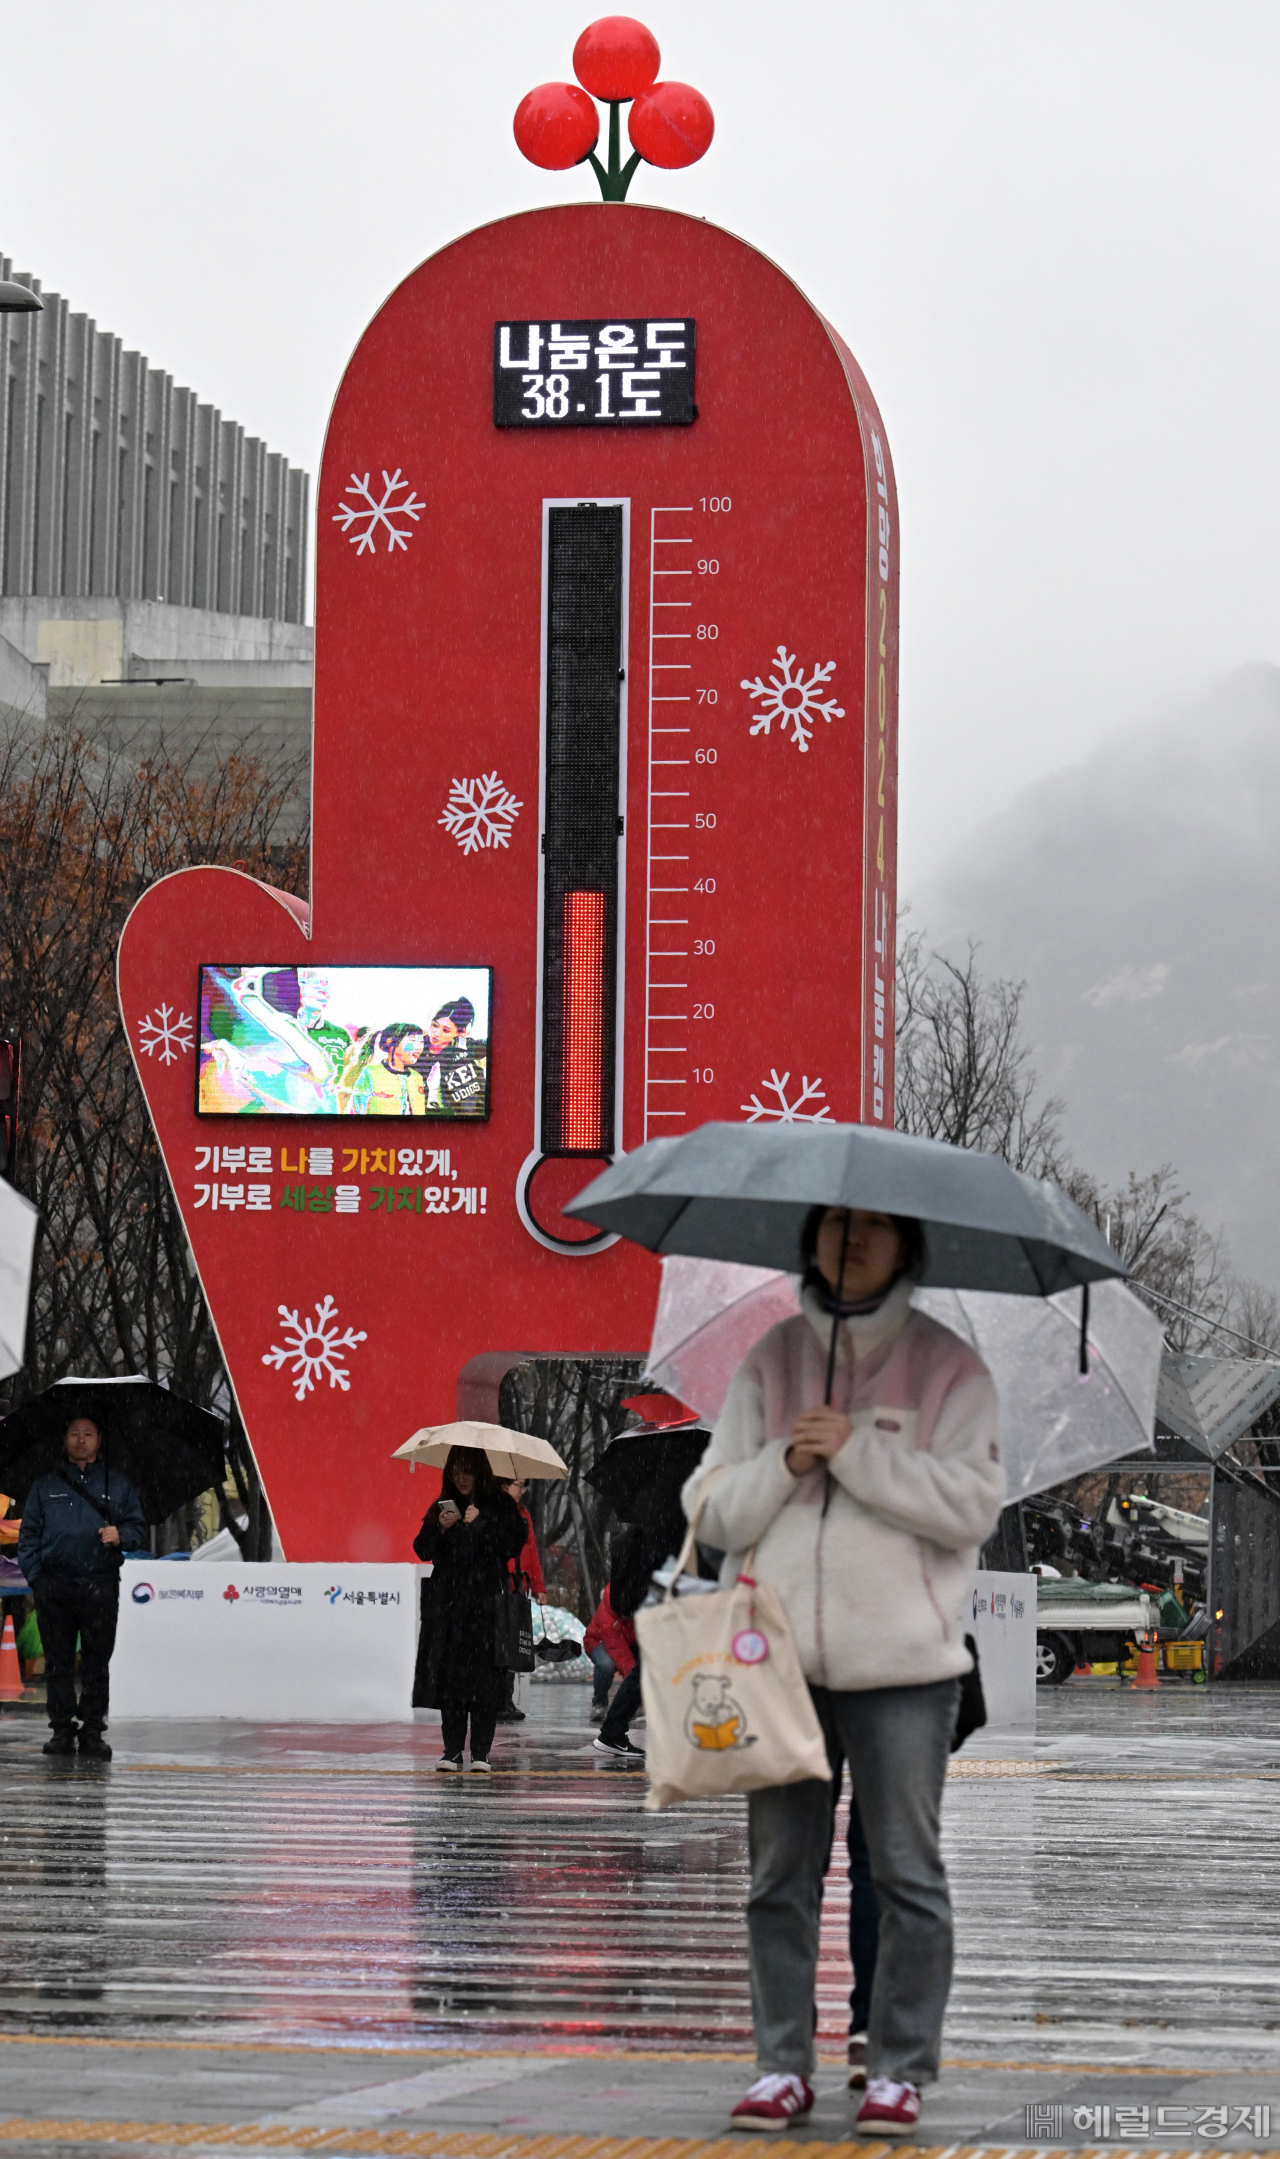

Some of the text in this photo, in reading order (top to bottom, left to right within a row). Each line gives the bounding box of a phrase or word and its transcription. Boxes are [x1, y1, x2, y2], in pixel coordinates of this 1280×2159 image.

[500, 322, 686, 370] 나눔온도
[521, 371, 662, 418] 38.1도
[699, 497, 732, 513] 100
[697, 559, 720, 575] 90
[696, 624, 719, 640] 80
[696, 689, 718, 705] 70
[695, 748, 718, 764] 60
[694, 813, 717, 829] 50
[693, 878, 716, 894] 40
[693, 939, 716, 955] 30
[692, 1004, 715, 1019] 20
[692, 1068, 714, 1084] 10
[194, 1146, 457, 1181] 기부로 나를 가치있게,
[193, 1183, 487, 1215] 기부로 세상을 가치있게!
[343, 1591, 400, 1606] 서울특별시
